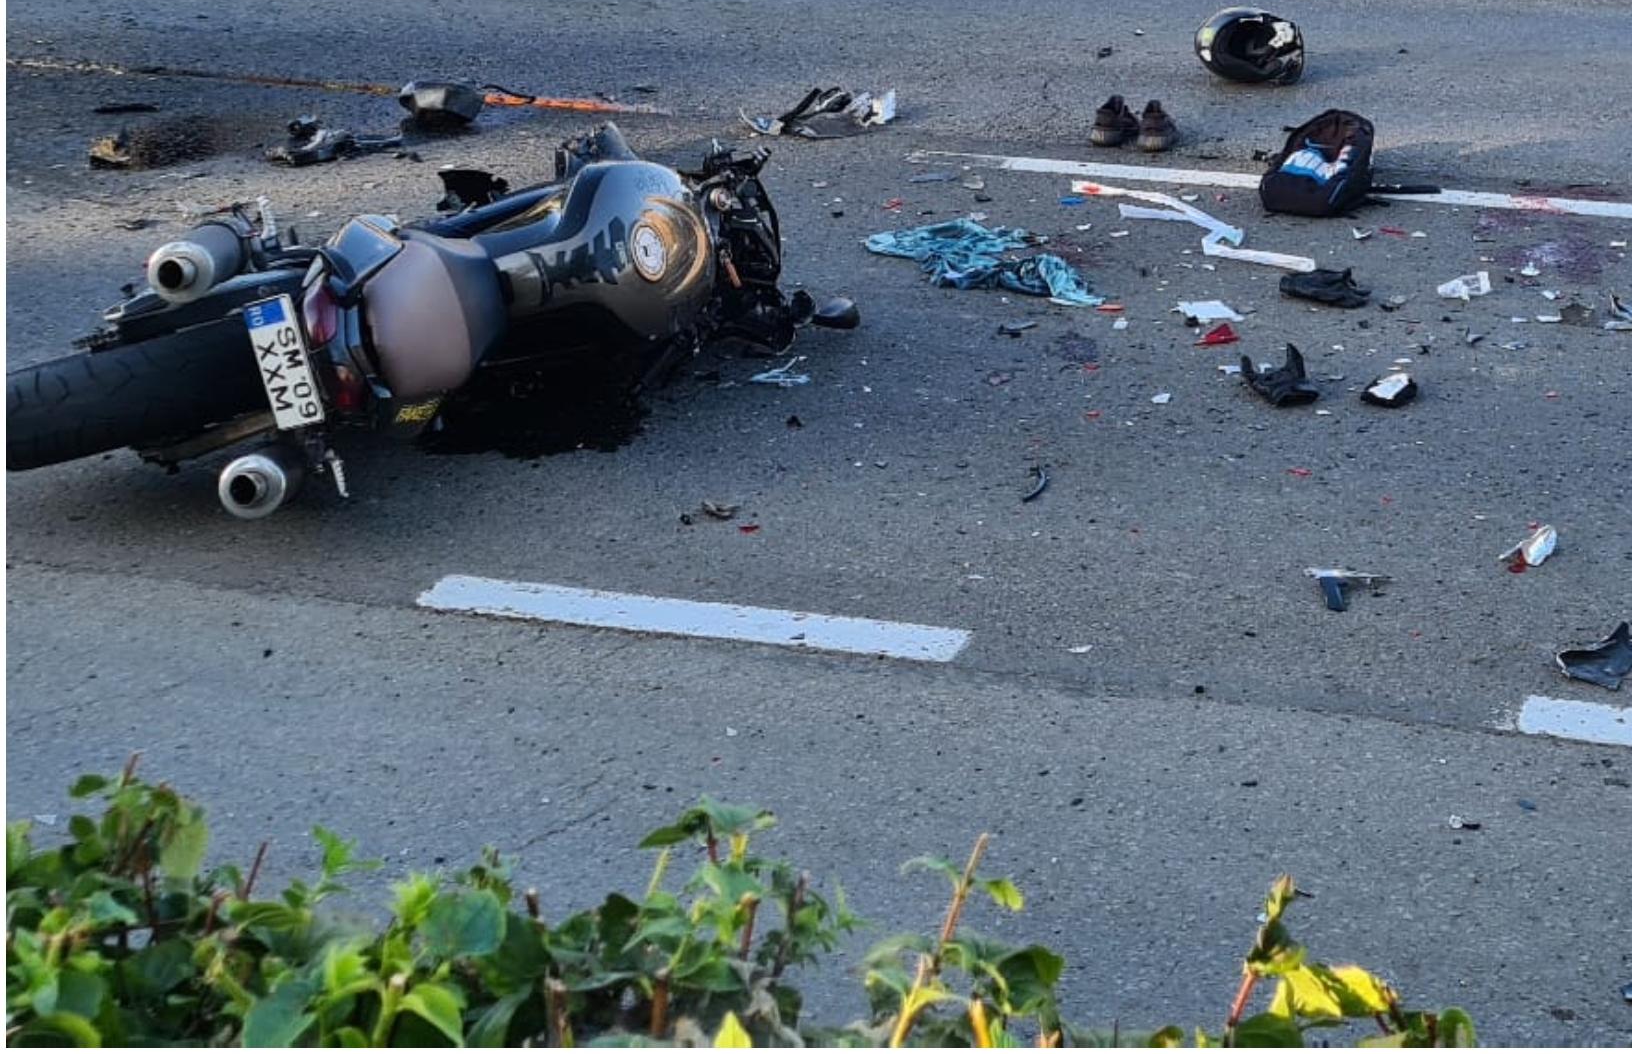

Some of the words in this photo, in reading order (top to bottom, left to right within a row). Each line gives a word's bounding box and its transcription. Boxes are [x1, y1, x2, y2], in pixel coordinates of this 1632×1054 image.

[257, 340, 293, 411] XXM
[277, 326, 304, 370] SM
[293, 381, 318, 418] 09
